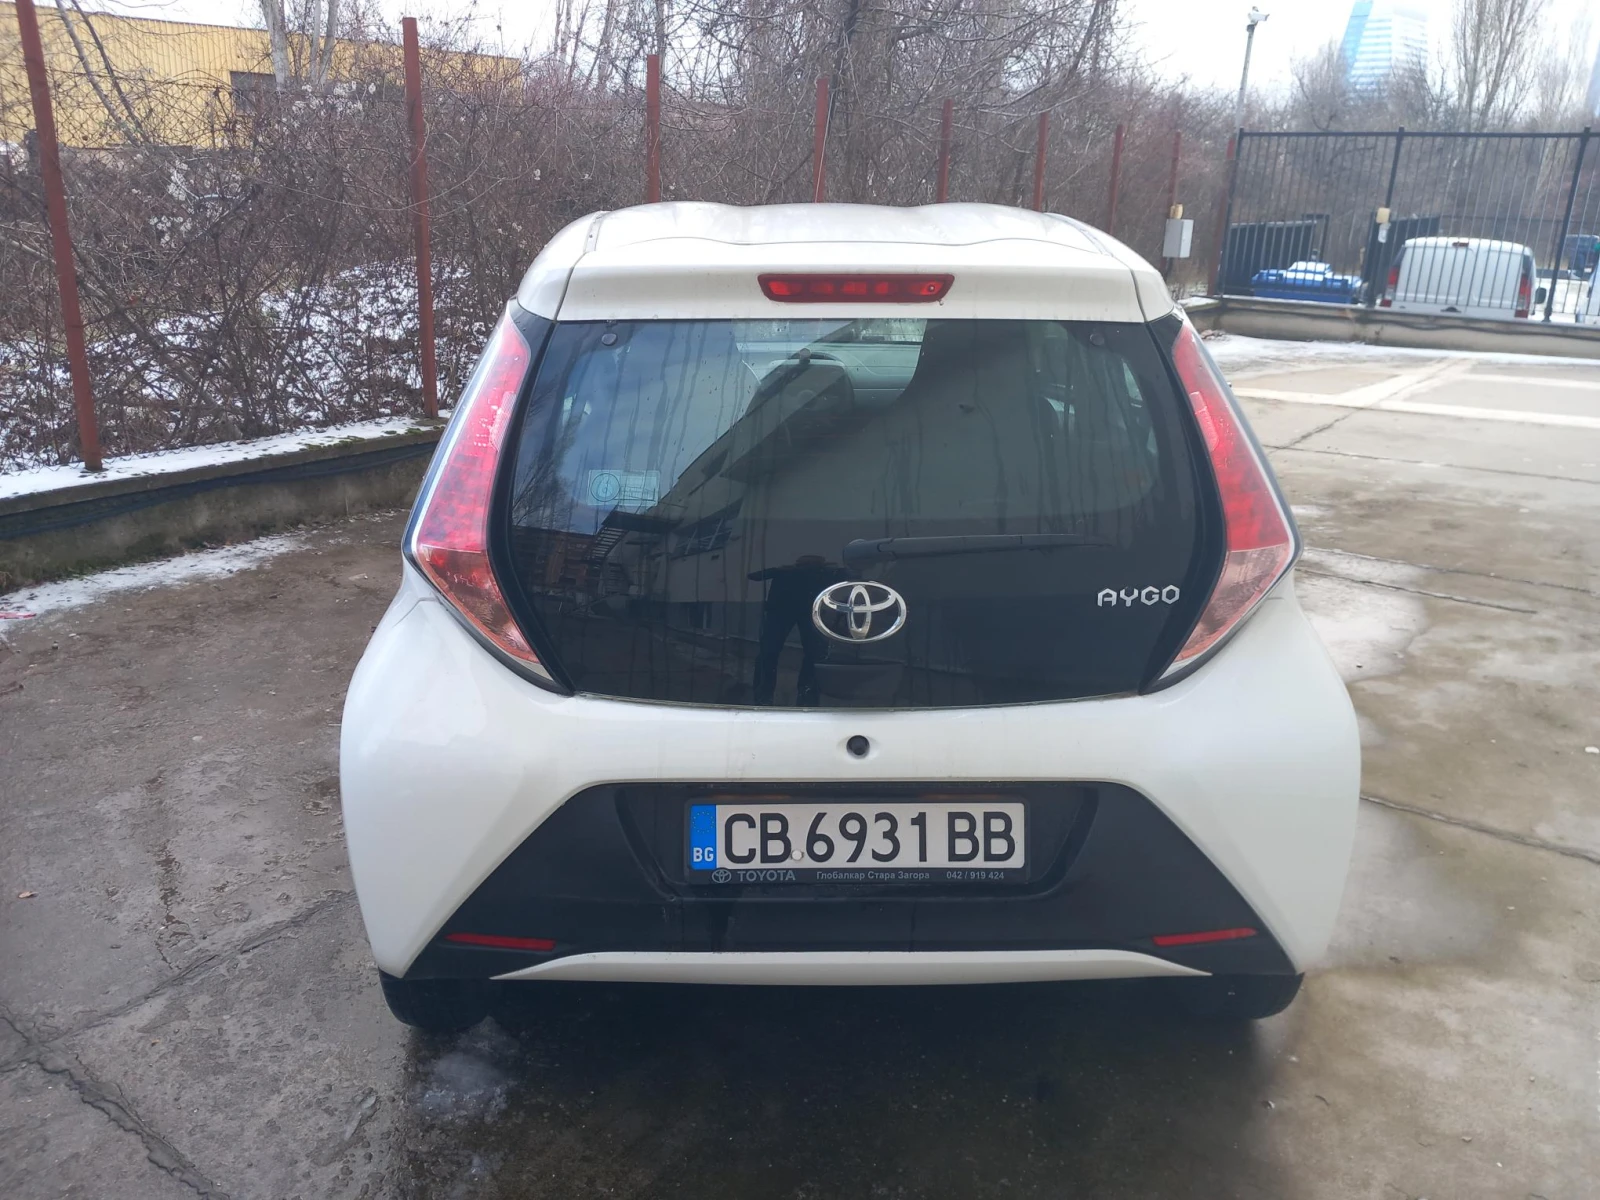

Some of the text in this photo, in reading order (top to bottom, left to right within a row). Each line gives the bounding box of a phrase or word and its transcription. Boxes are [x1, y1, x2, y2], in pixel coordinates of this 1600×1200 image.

[1097, 584, 1180, 607] AYGO
[724, 811, 1016, 864] CB 6931 BB
[693, 847, 714, 862] BG
[737, 870, 796, 881] TOYOTA
[816, 871, 930, 881] Глобалкар Стара Загора
[946, 871, 963, 880] 042
[970, 871, 986, 880] 919
[988, 871, 1005, 880] 424
